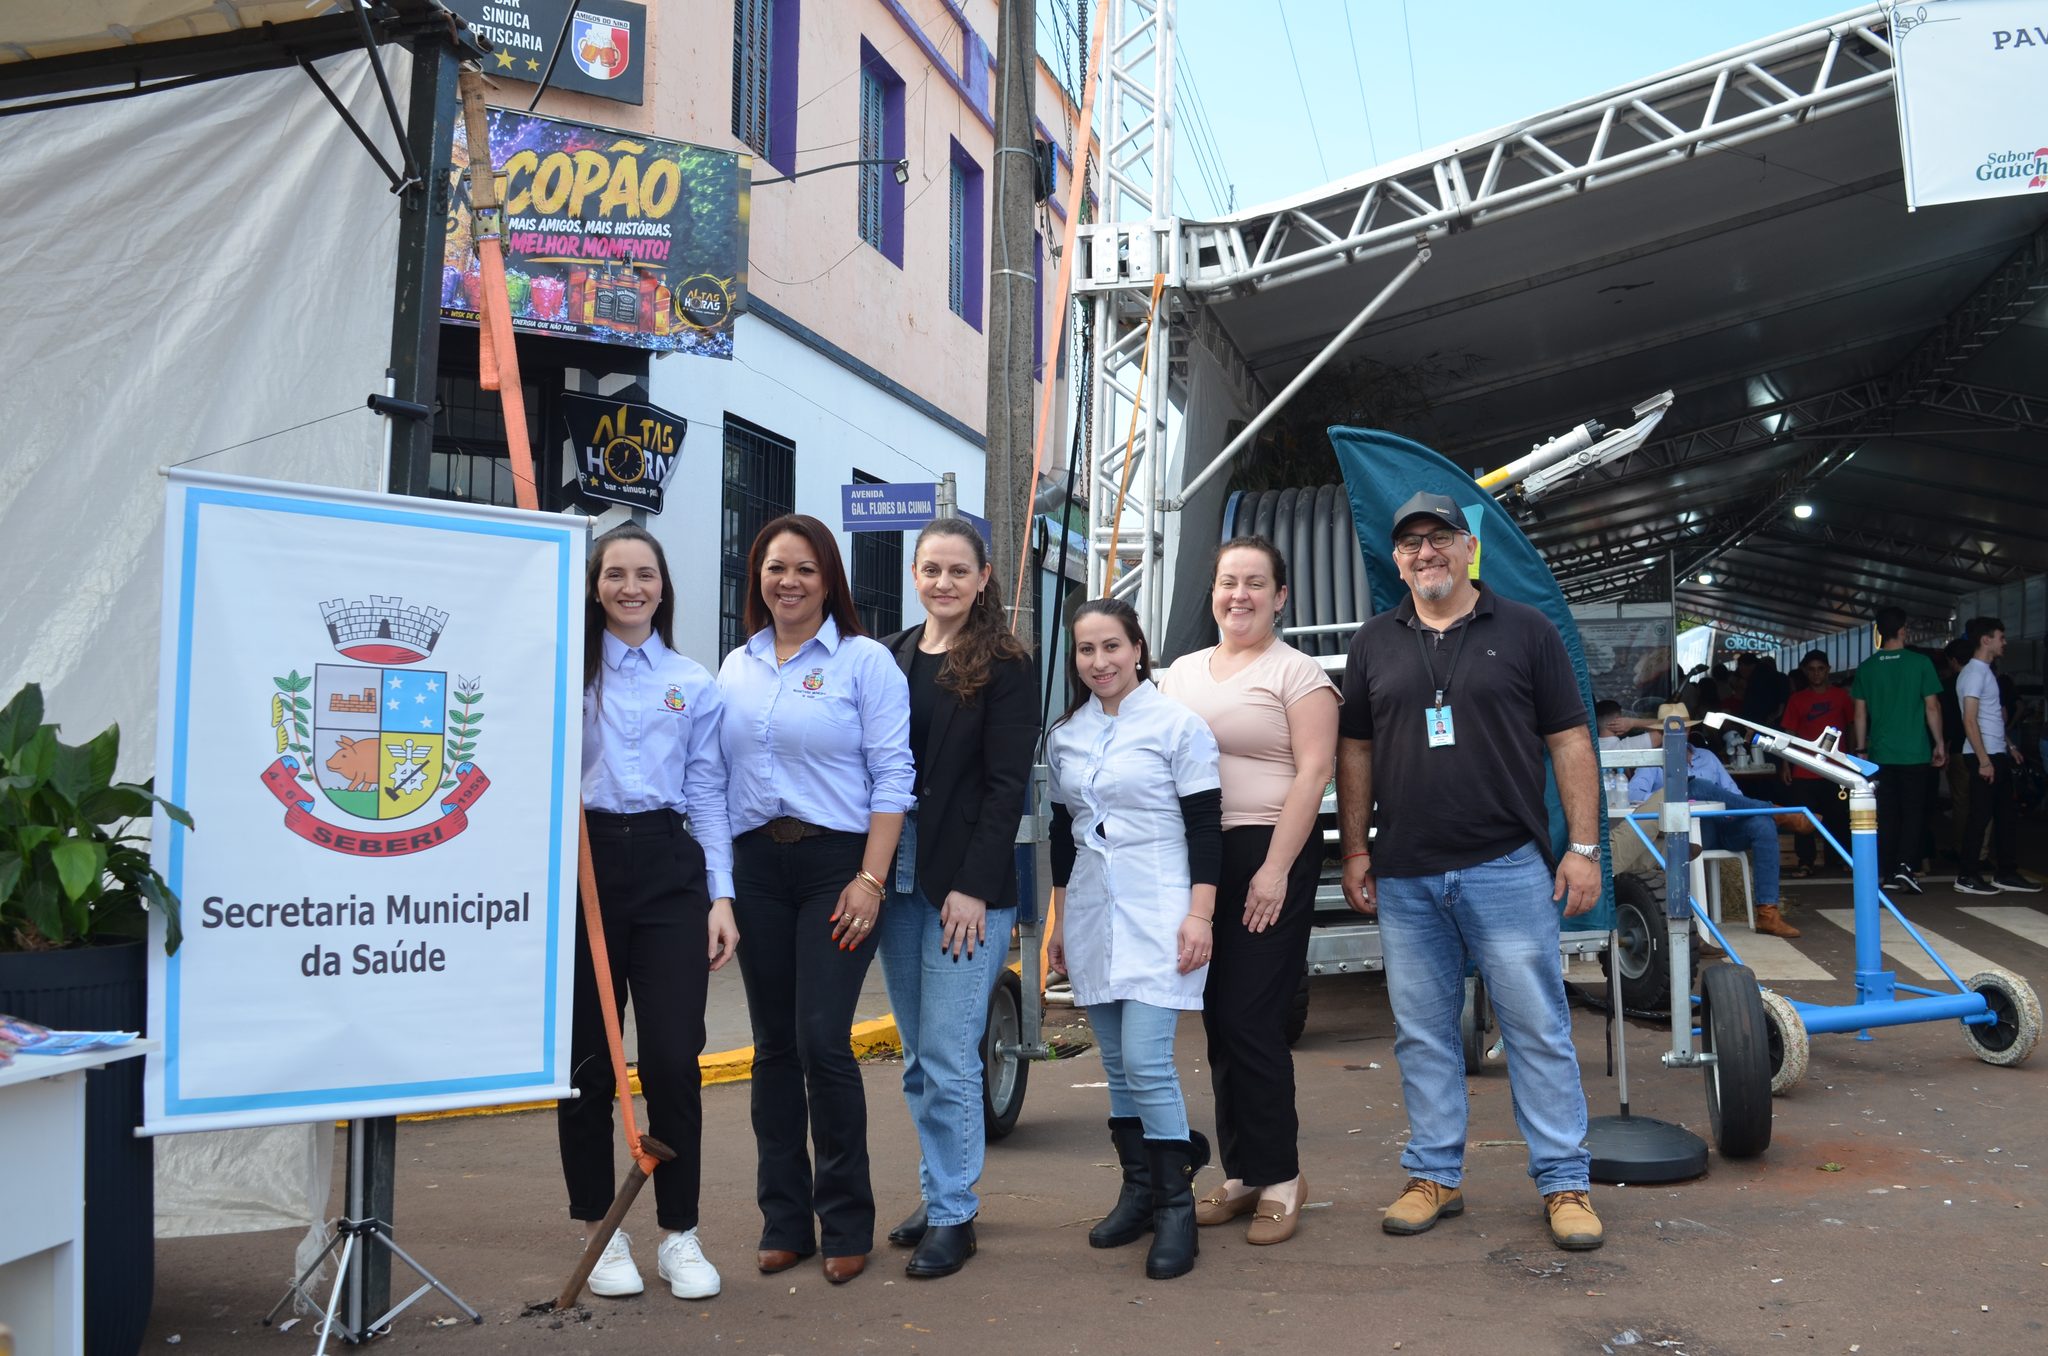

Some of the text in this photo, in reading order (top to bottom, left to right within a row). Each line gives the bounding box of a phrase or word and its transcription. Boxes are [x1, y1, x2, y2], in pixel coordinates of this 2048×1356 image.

[482, 5, 530, 30] SINUCA
[576, 12, 600, 22] AMIGOS
[1987, 150, 2034, 165] Sabor
[494, 140, 682, 219] COPÃO
[508, 217, 672, 238] MAIS AMIGOS, MAIS HISTÓRIAS,
[509, 232, 671, 260] MELHOR MOMENTO!
[687, 288, 720, 302] ALTAS
[592, 403, 674, 453] ALTAS
[603, 481, 617, 491] bar
[851, 489, 884, 499] AVENIDA
[851, 500, 932, 516] GAL. FLORES DA CUNHA
[457, 774, 486, 804] 1959
[312, 826, 444, 854] SEBERI
[202, 891, 530, 930] Secretaria Municipal
[301, 939, 446, 977] da Saúde
